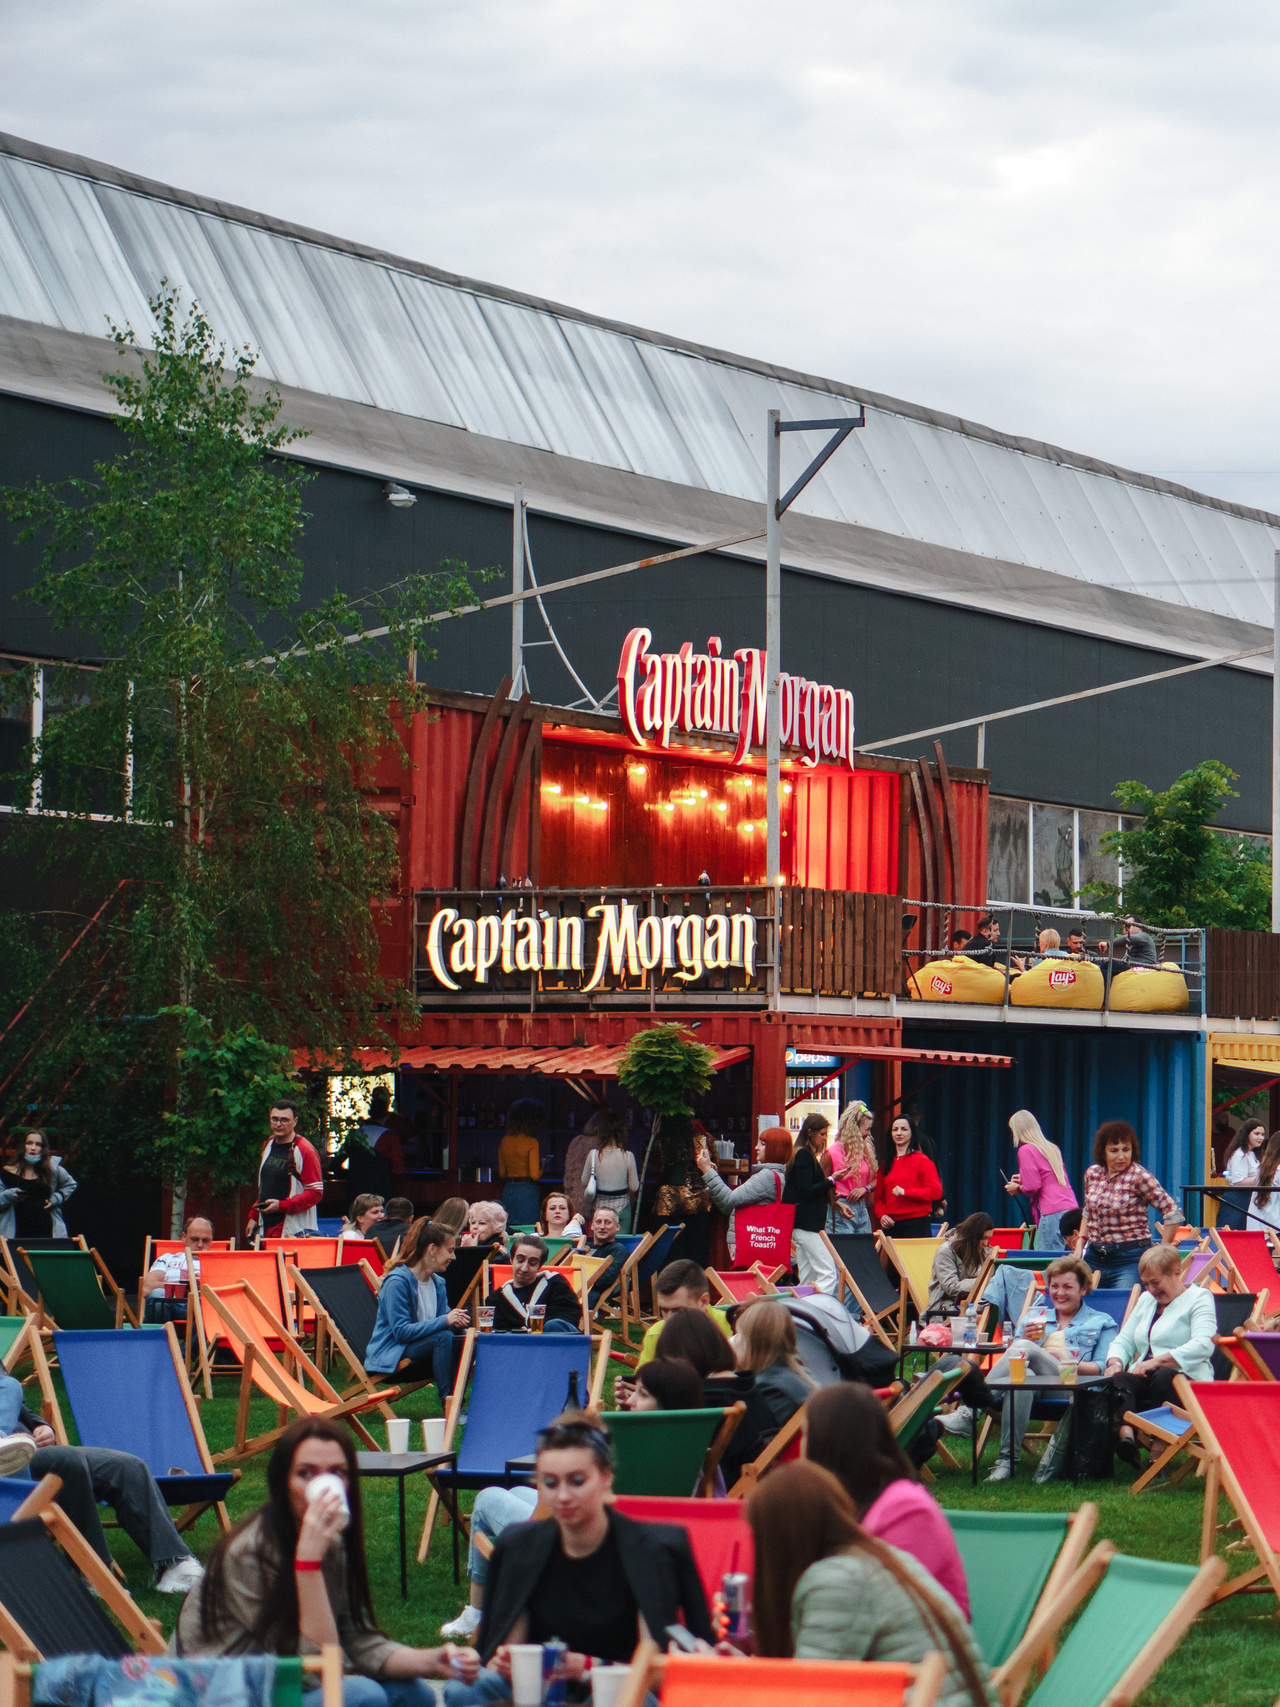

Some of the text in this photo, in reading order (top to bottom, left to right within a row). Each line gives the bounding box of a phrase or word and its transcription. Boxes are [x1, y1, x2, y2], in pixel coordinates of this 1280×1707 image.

[617, 627, 855, 773] Captain Morgan
[426, 904, 757, 993] Captain Morgan
[746, 1225, 781, 1234] What The
[750, 1234, 776, 1242] French
[749, 1240, 776, 1249] Toast?!
